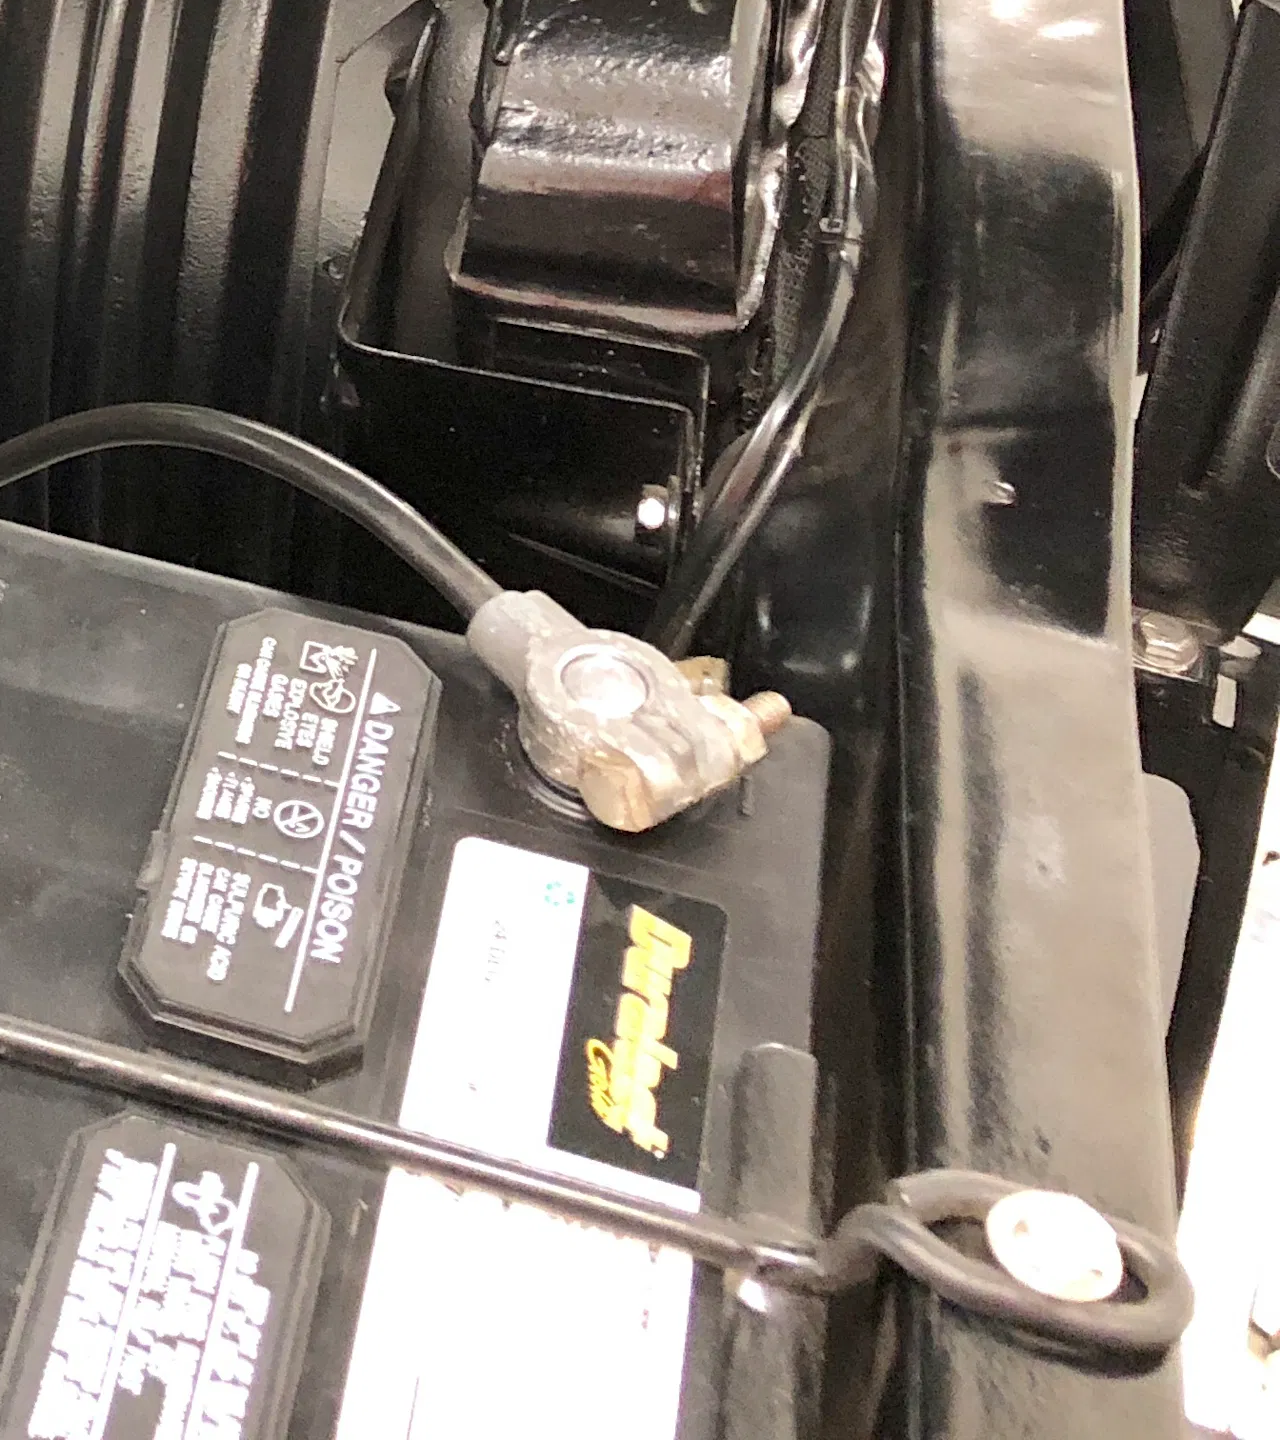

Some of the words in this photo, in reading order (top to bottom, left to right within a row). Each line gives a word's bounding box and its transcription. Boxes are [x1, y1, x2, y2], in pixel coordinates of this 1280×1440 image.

[274, 678, 308, 750] EXPLOSIVE
[342, 719, 394, 829] DANGER
[310, 854, 364, 964] POISON
[612, 903, 693, 1154] Duralast
